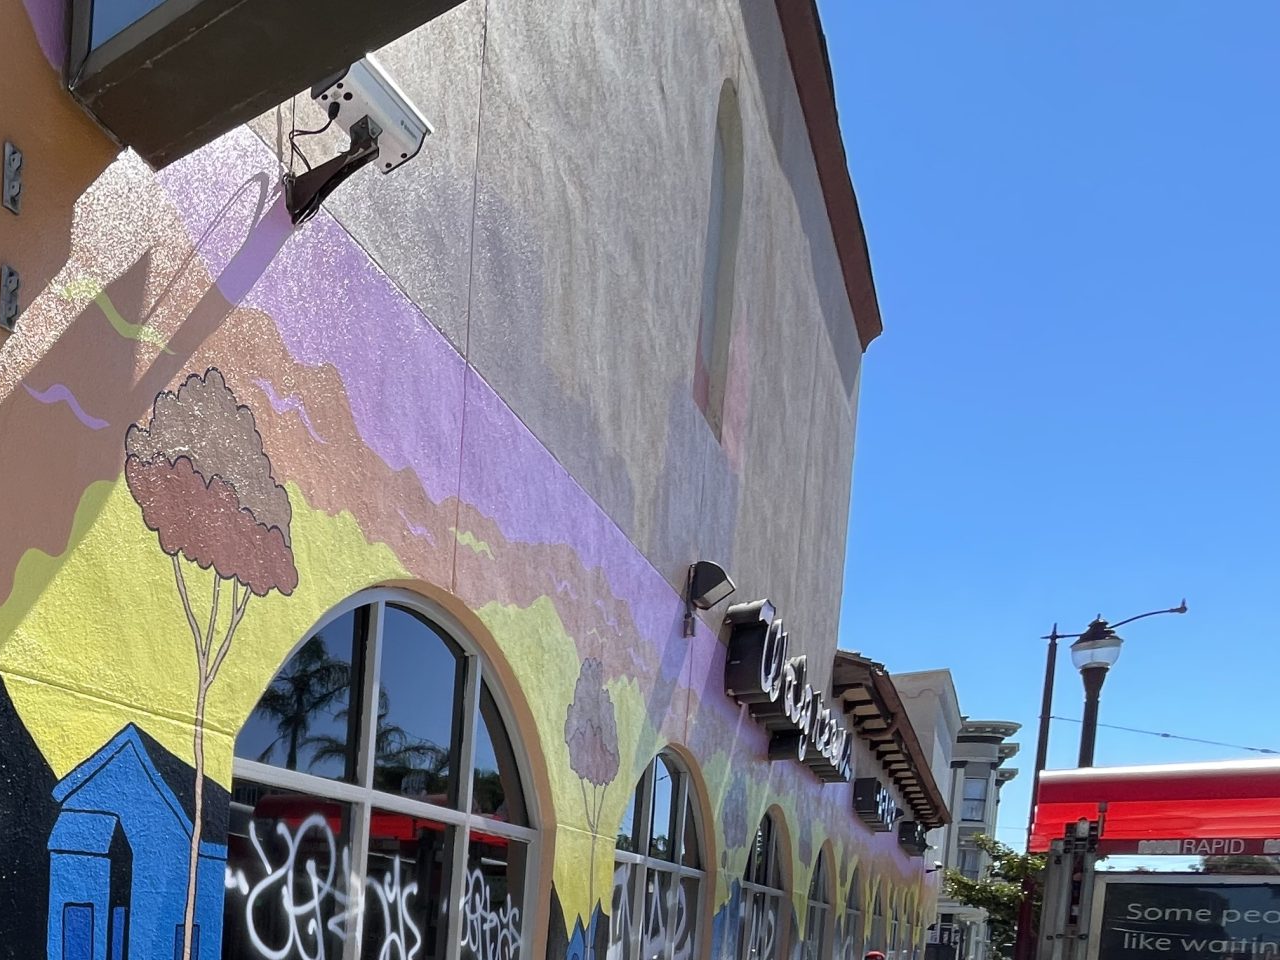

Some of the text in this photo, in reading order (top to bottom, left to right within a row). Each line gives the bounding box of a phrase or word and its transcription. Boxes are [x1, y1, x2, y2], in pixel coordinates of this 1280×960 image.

[1182, 838, 1245, 855] RAPID
[1126, 903, 1212, 922] Some
[1123, 933, 1171, 951] like
